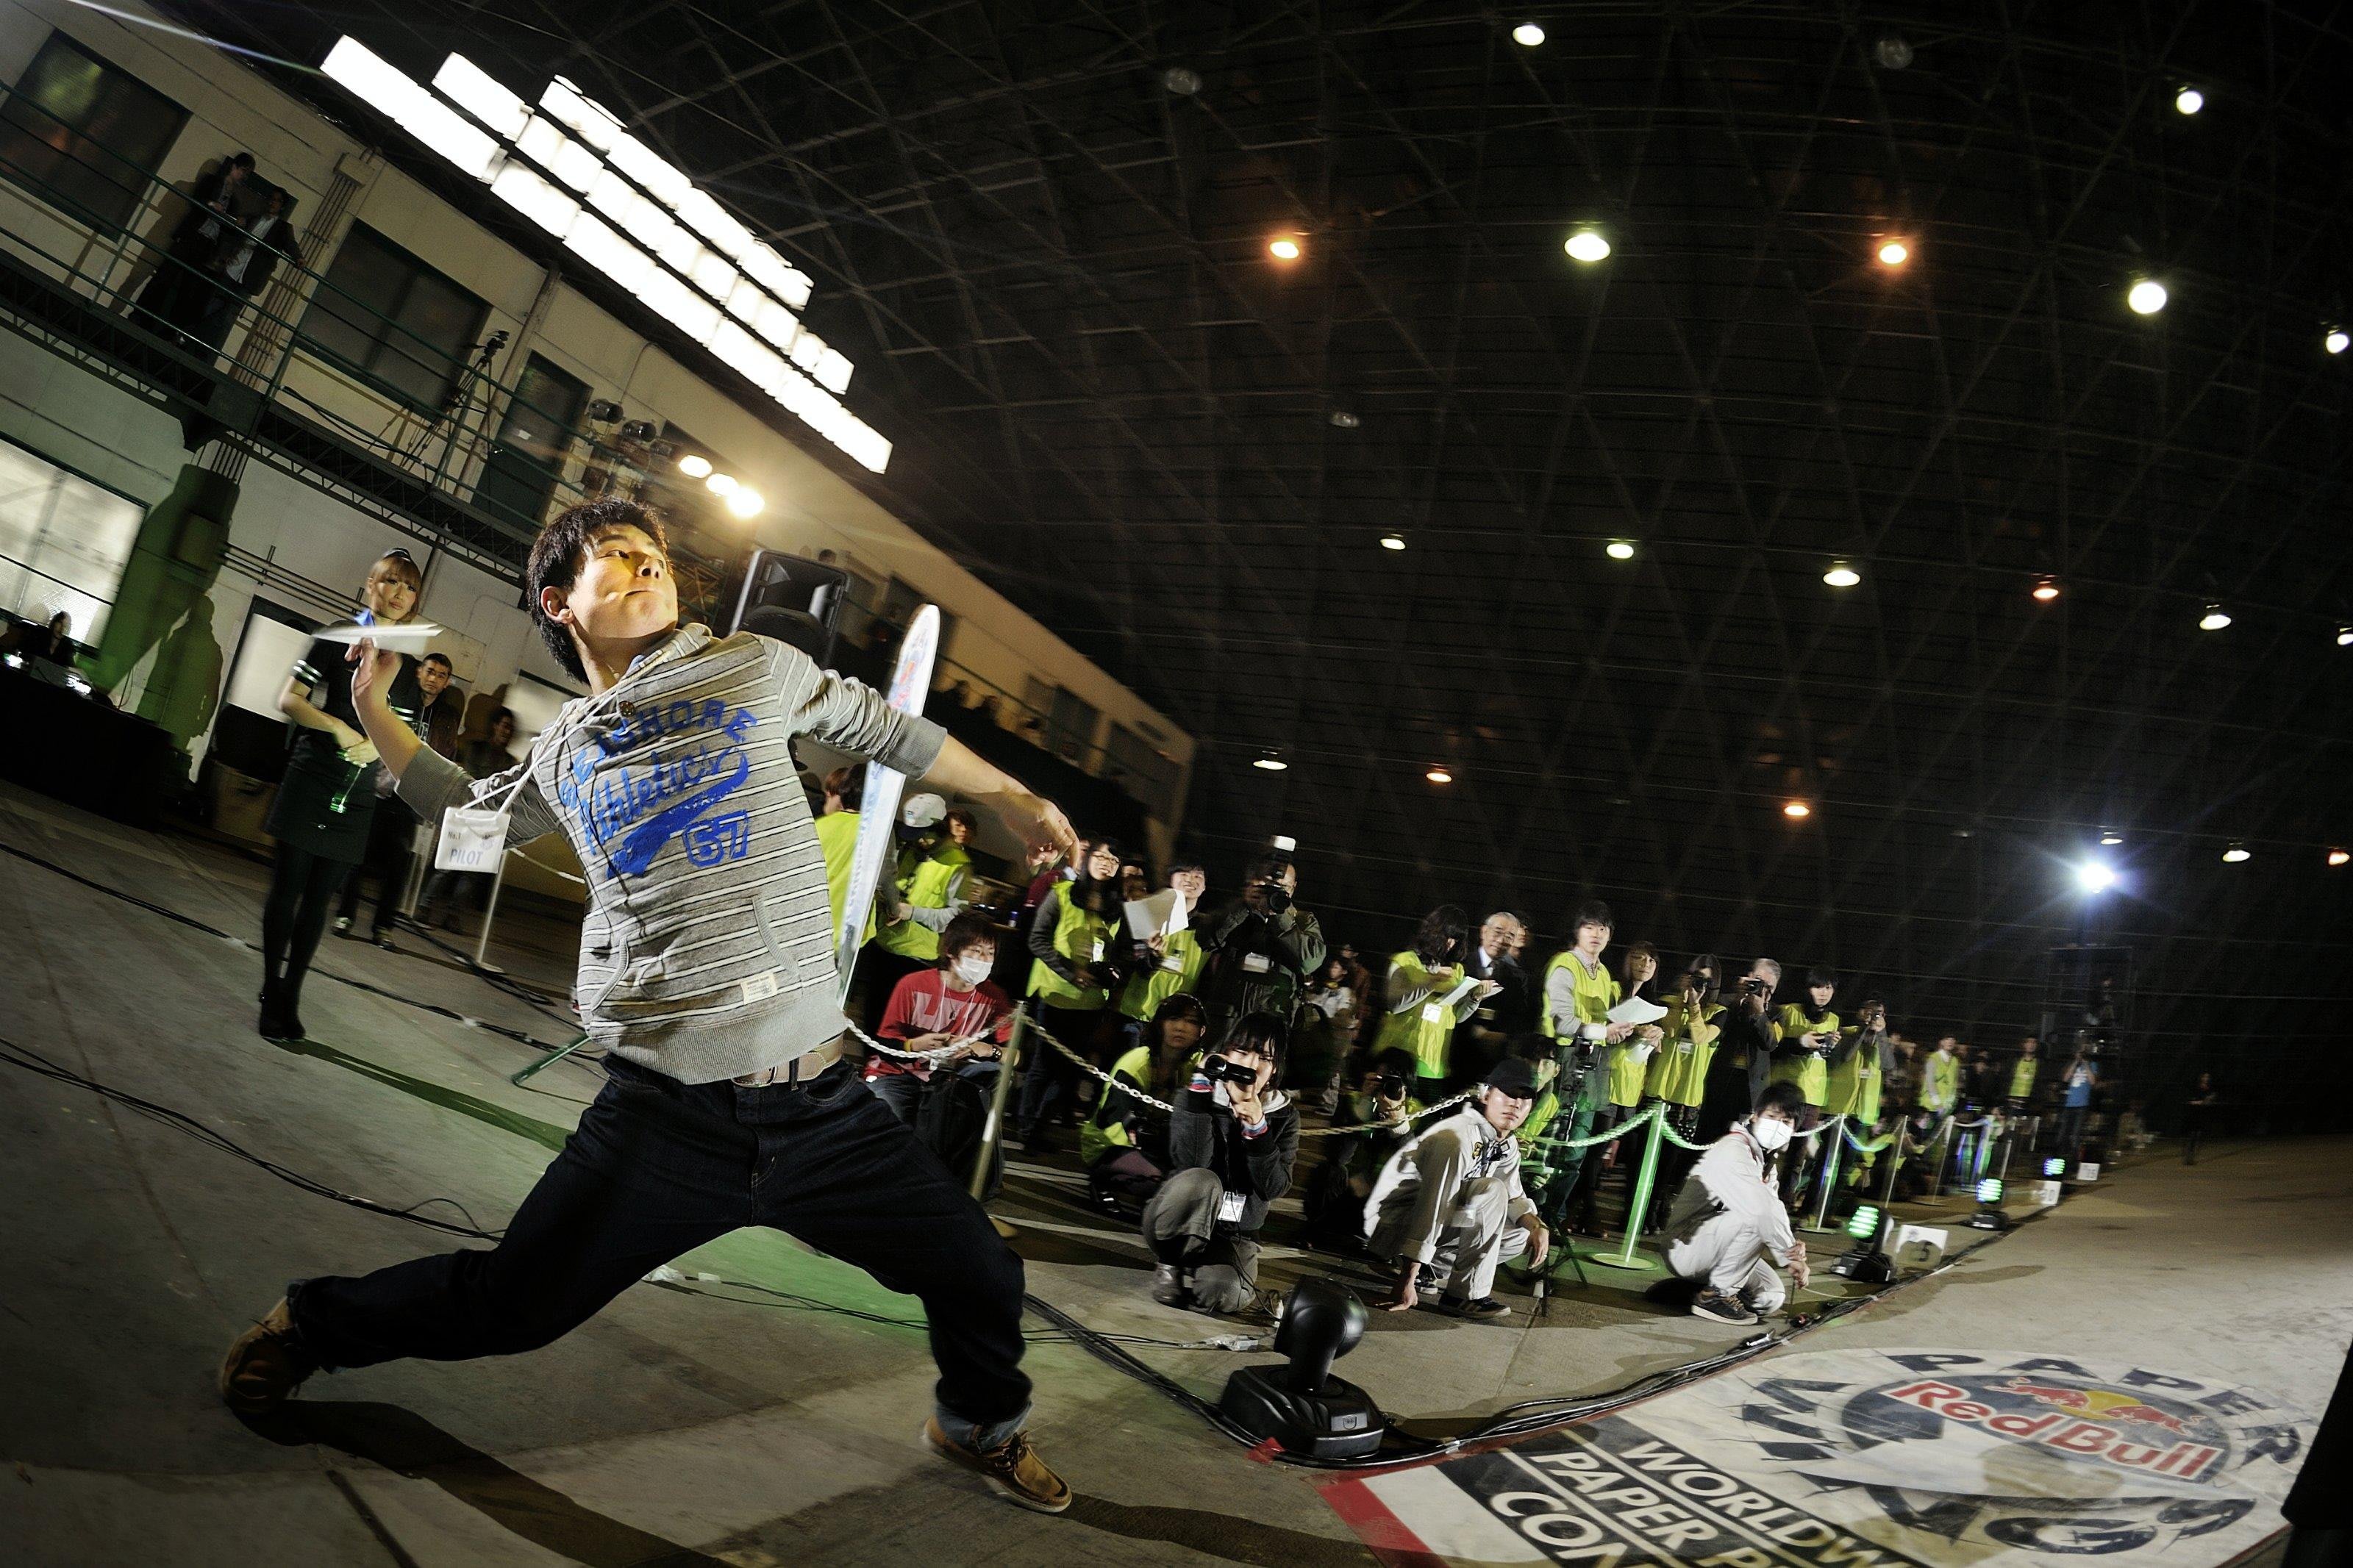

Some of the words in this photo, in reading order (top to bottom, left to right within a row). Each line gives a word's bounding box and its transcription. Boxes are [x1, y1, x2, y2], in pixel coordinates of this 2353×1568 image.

[449, 848, 483, 865] PILOT
[682, 810, 749, 867] 67
[1884, 1382, 2059, 1439] Red
[2044, 1422, 2221, 1481] Bull
[1886, 1353, 2302, 1469] PAPER
[1529, 1453, 1718, 1550] PAPER
